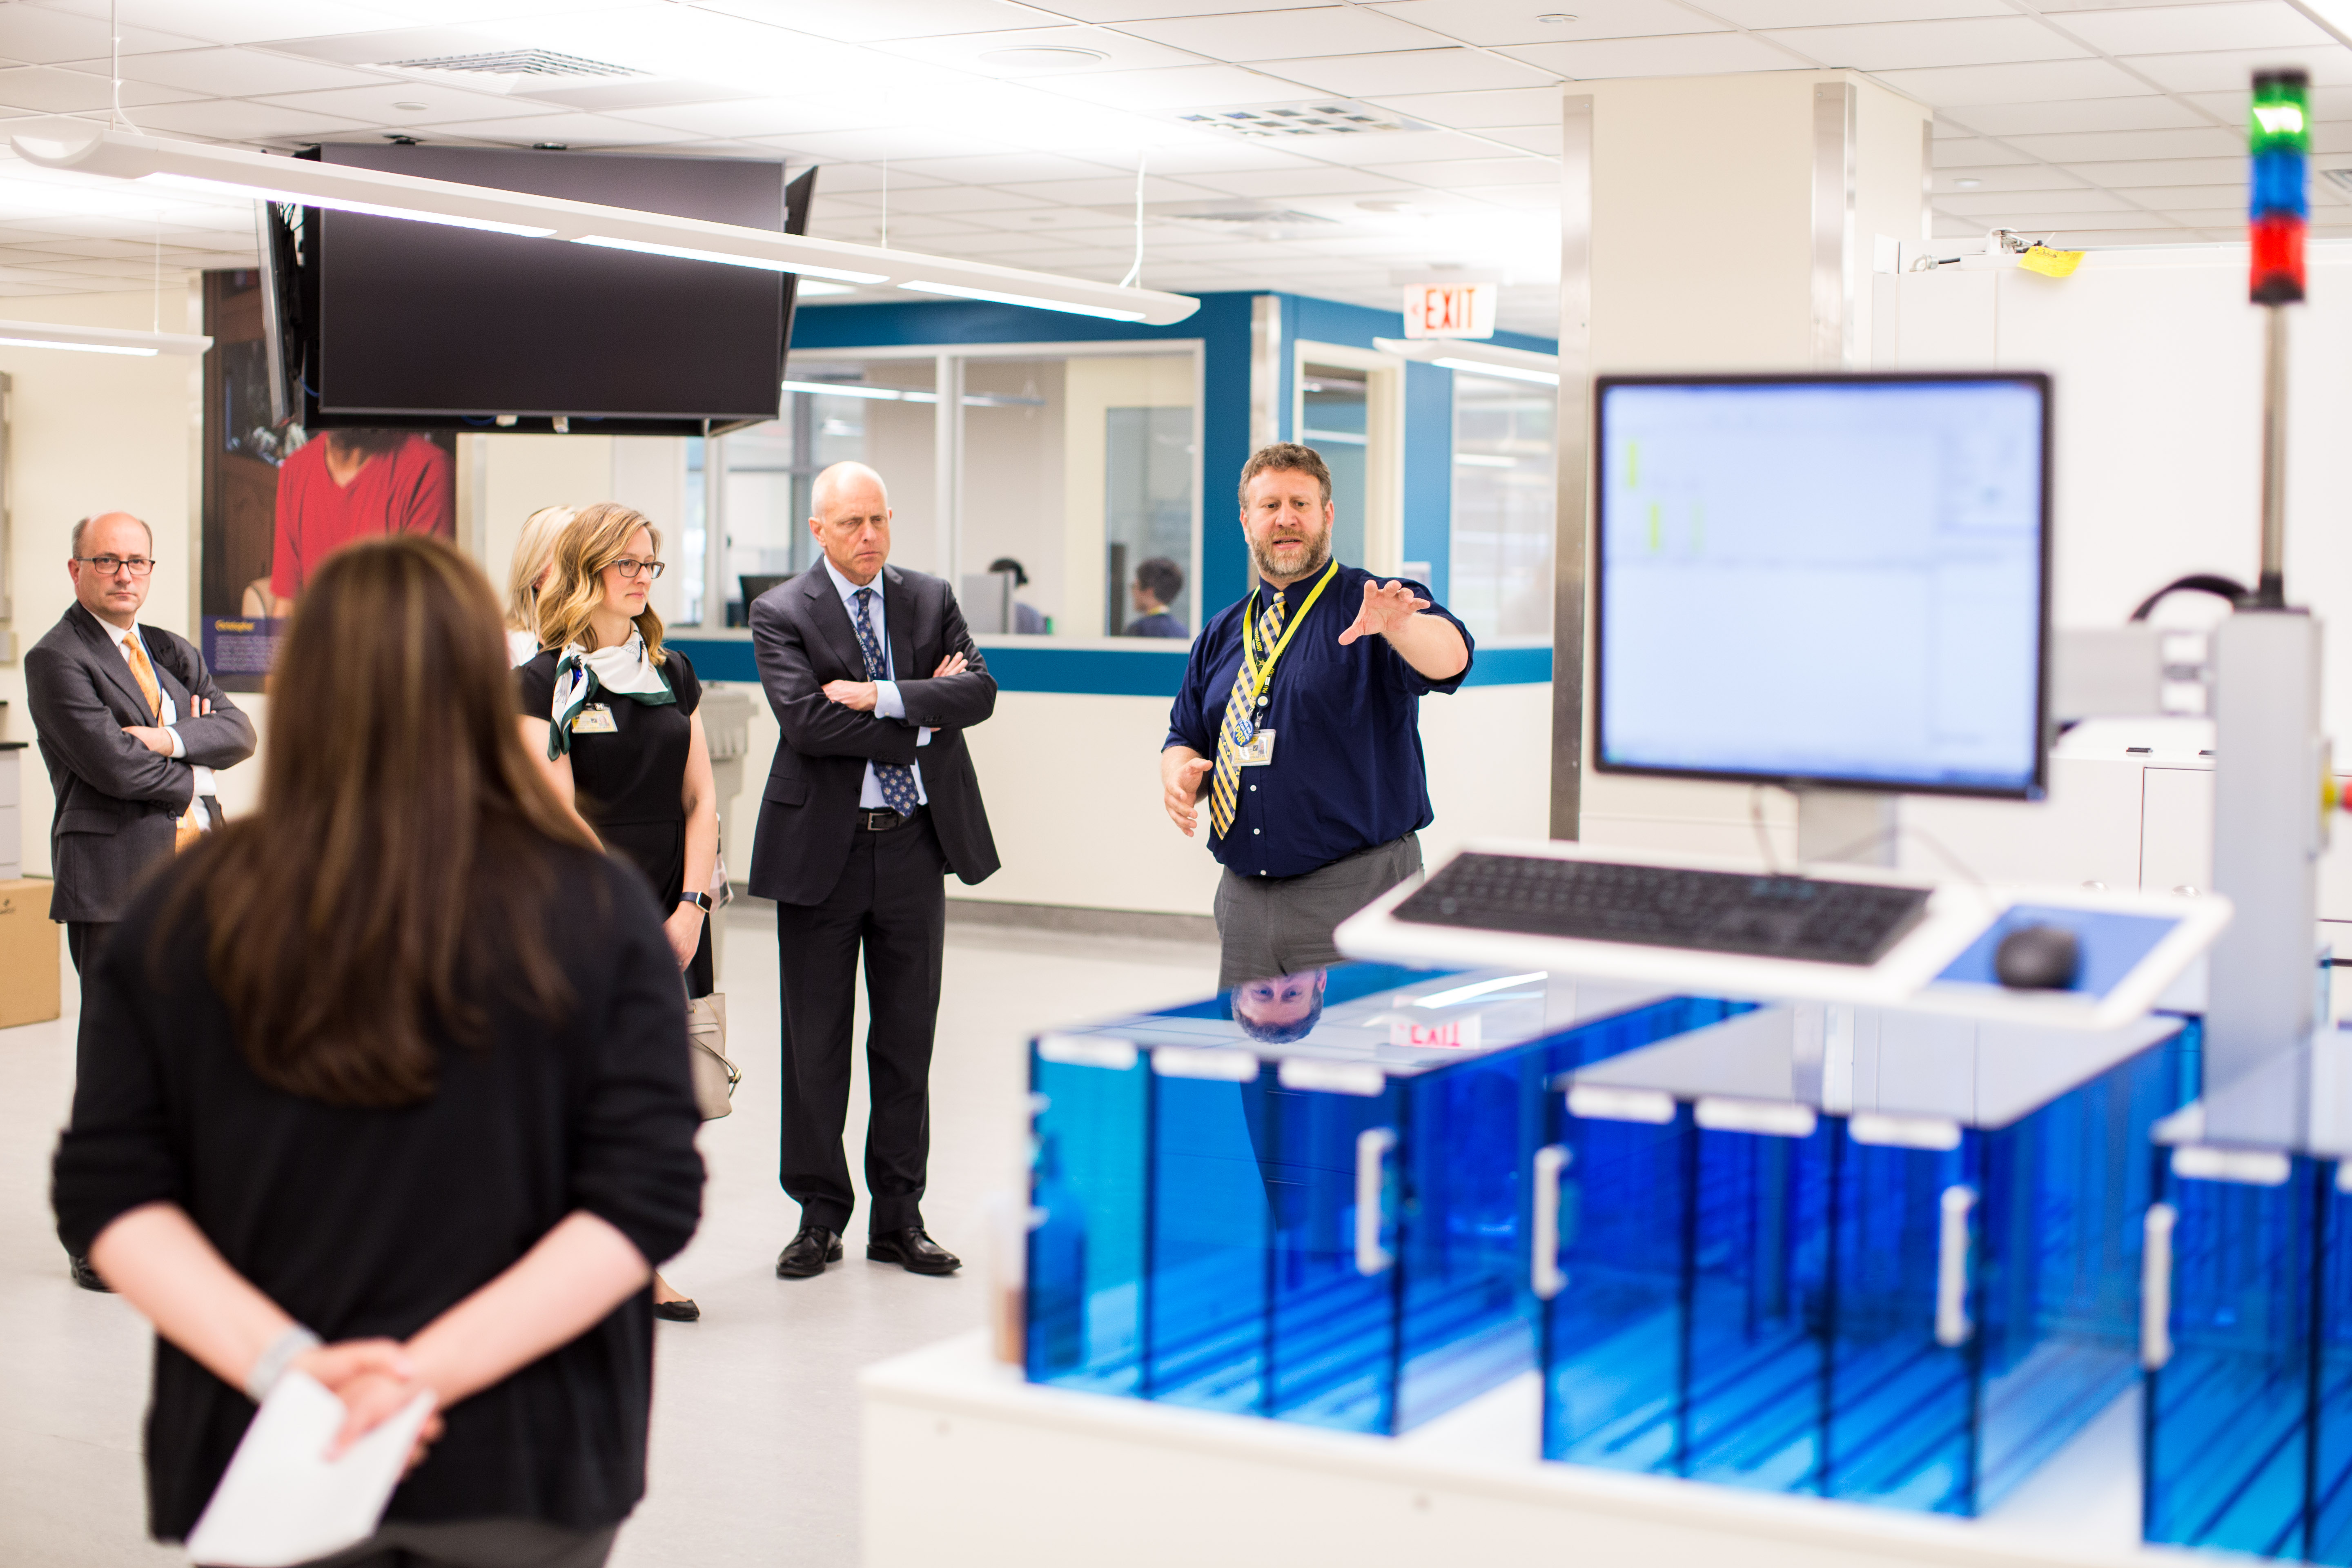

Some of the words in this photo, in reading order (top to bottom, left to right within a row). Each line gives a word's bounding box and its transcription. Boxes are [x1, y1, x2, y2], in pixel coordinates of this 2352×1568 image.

[1425, 289, 1475, 329] EXIT
[865, 652, 876, 673] SURGERY
[1235, 725, 1246, 746] PRR
